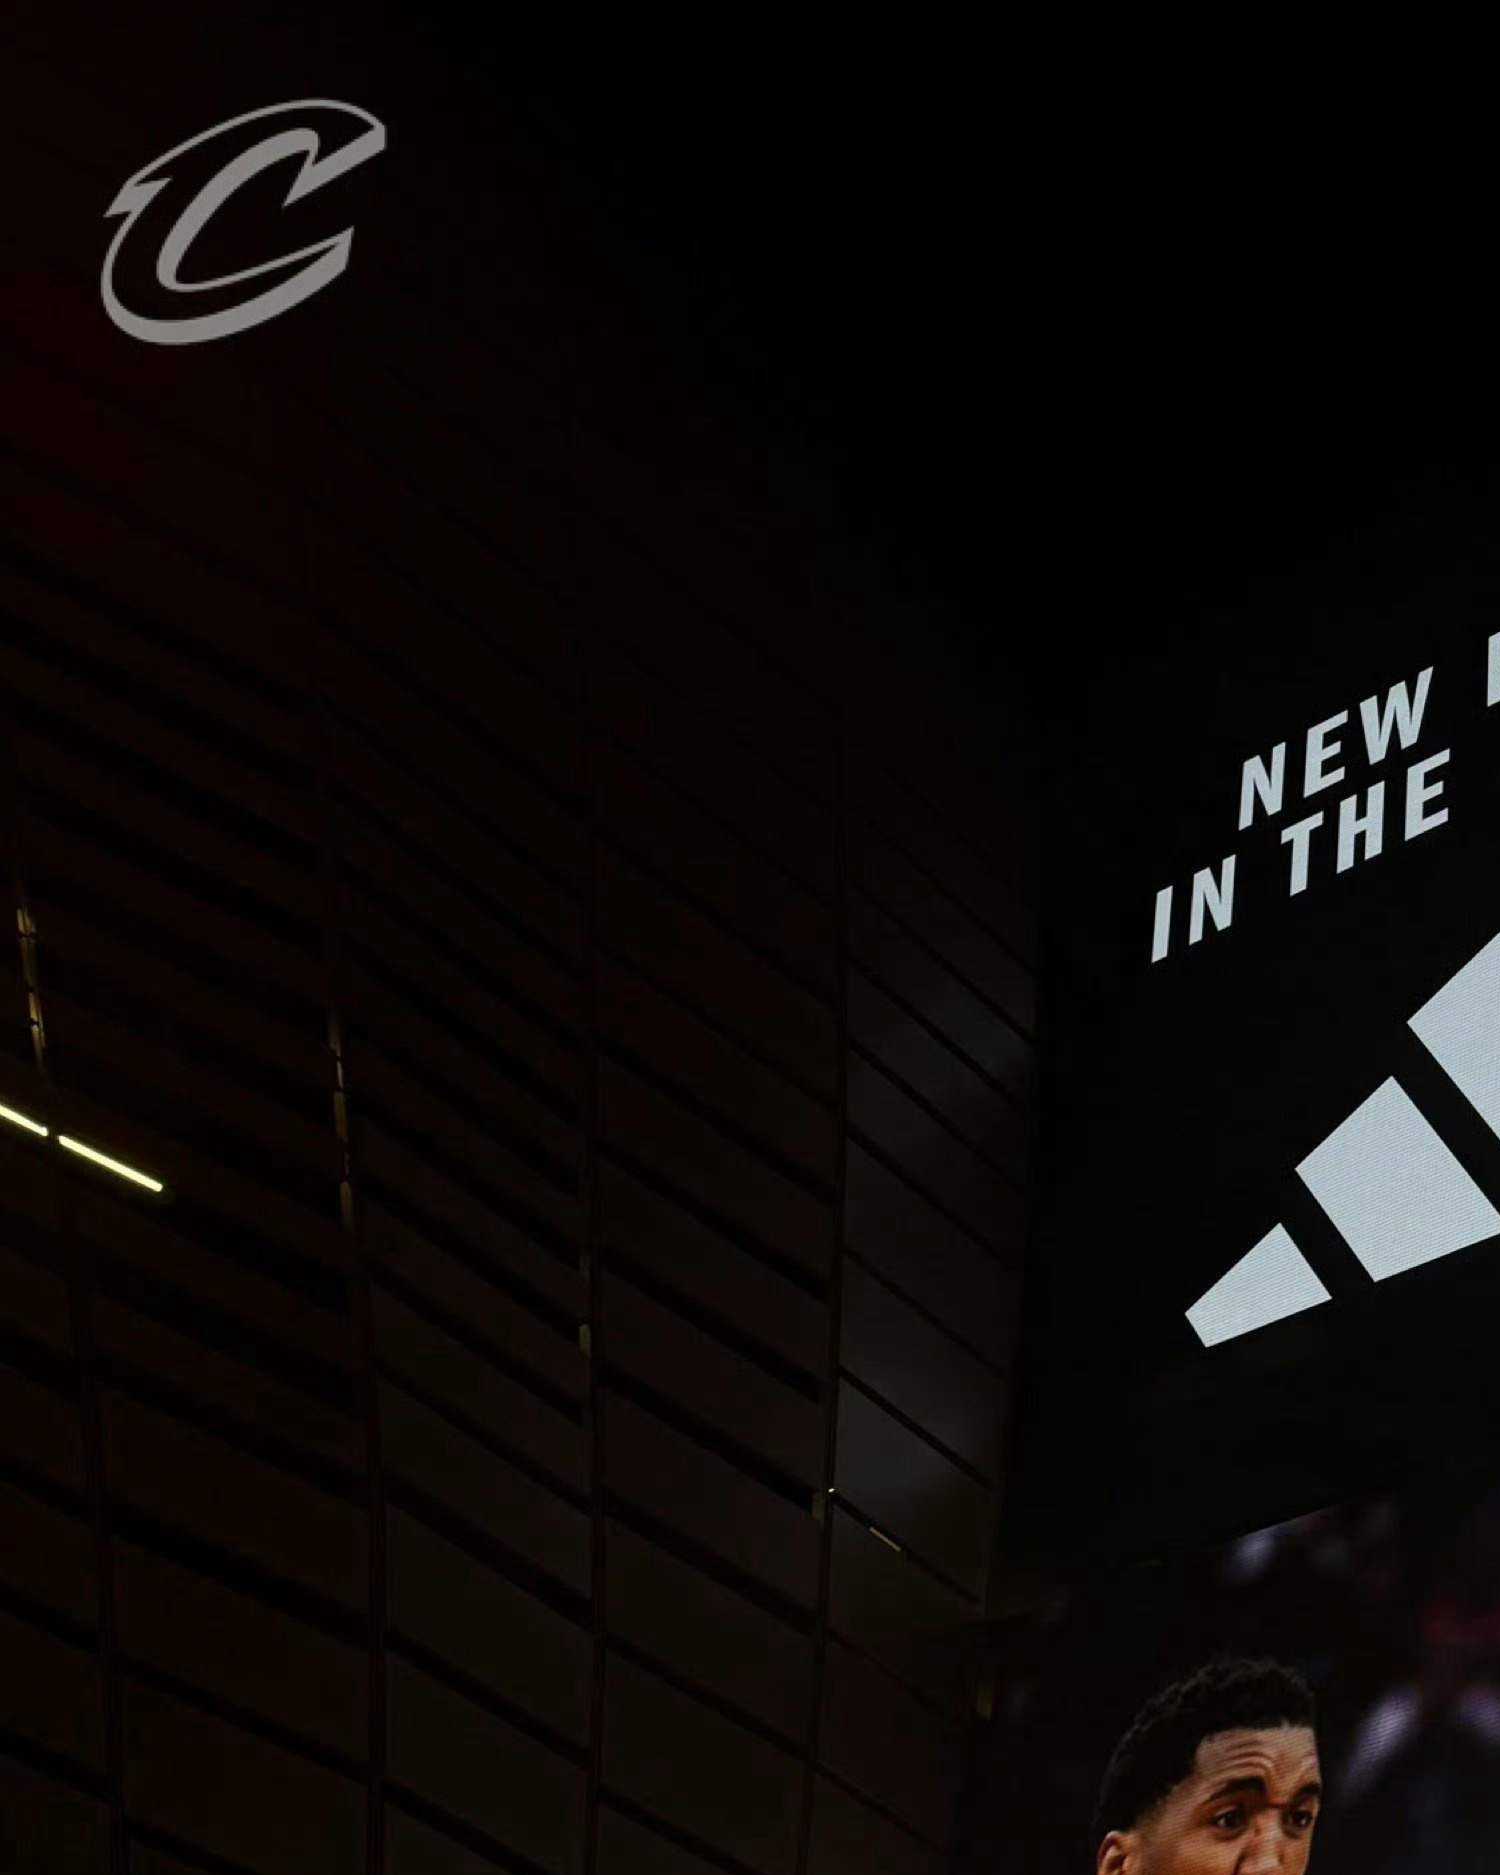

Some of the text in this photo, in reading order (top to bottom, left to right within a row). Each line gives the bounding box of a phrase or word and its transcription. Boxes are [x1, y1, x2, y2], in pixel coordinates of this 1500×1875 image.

[1238, 665, 1434, 831] NEW
[1151, 853, 1237, 963] IN
[1280, 747, 1451, 897] THE
